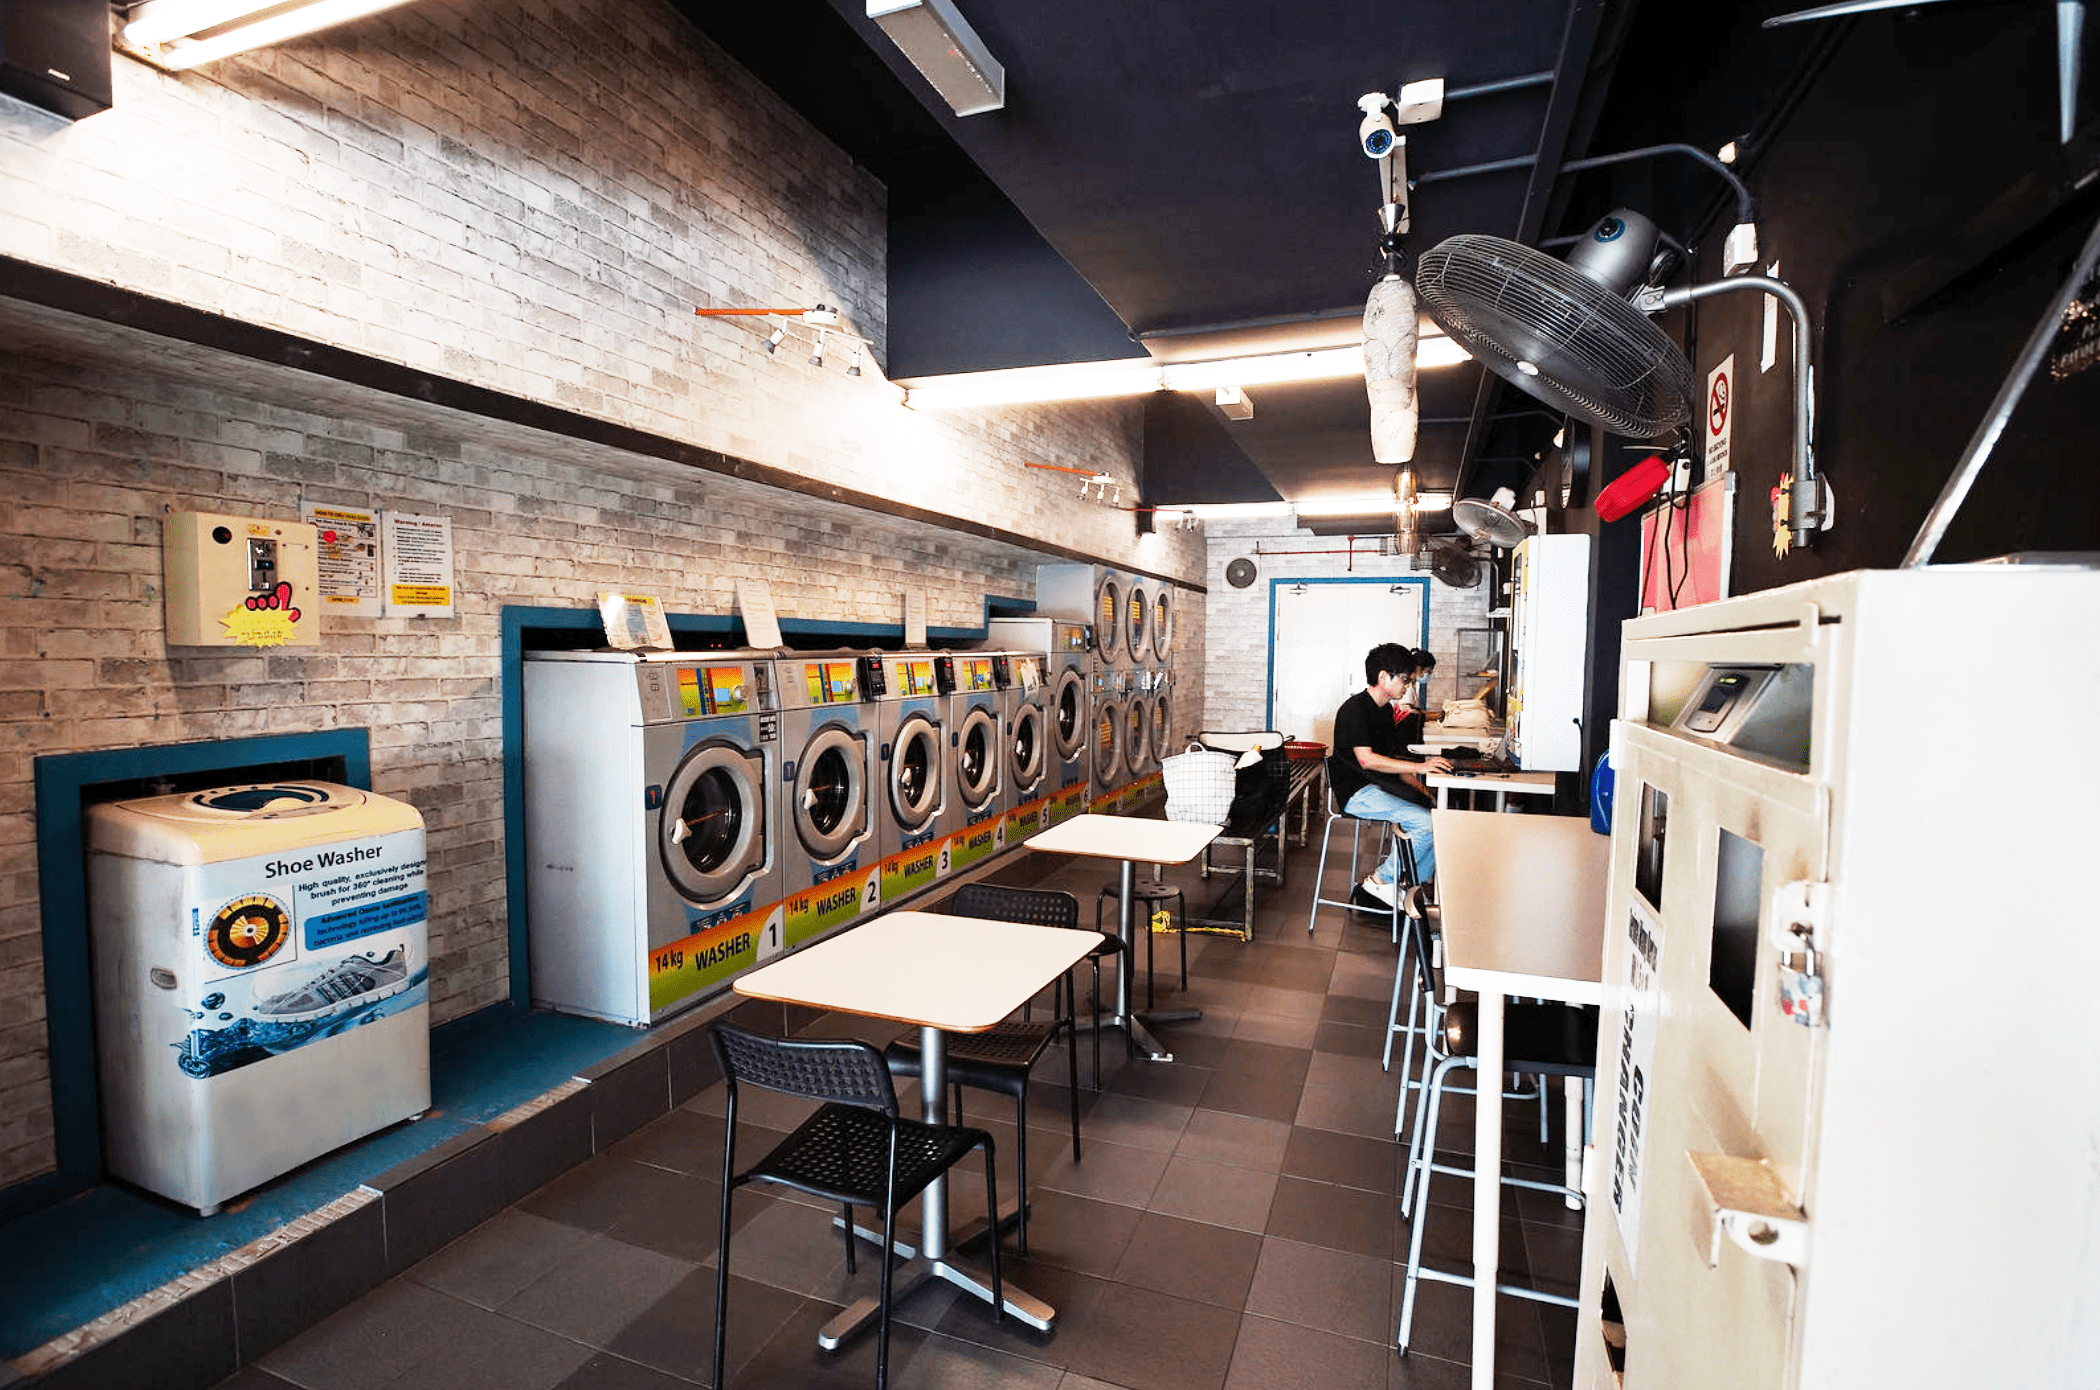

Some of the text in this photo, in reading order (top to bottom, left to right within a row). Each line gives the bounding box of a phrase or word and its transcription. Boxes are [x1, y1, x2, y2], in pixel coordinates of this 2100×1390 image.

[1042, 807, 1048, 823] 5
[997, 827, 1003, 842] 4
[265, 846, 383, 878] Shoe Washer
[904, 855, 934, 878] WASHER
[941, 851, 949, 870] 3
[298, 881, 320, 892] High
[322, 875, 352, 887] quality,
[355, 865, 399, 880] exclusively
[310, 888, 337, 900] brush
[338, 885, 351, 894] for
[372, 873, 405, 886] cleaning
[406, 868, 424, 878] while
[331, 883, 409, 907] preventing damage
[817, 887, 857, 917] WASHER
[867, 881, 877, 902] 2
[316, 921, 357, 936] technology
[320, 910, 357, 925] Advanced
[313, 934, 344, 947] bacteria
[345, 929, 359, 940] and
[769, 923, 777, 948] 1
[695, 933, 751, 971] WASHER
[1627, 1064, 1645, 1193] COIN
